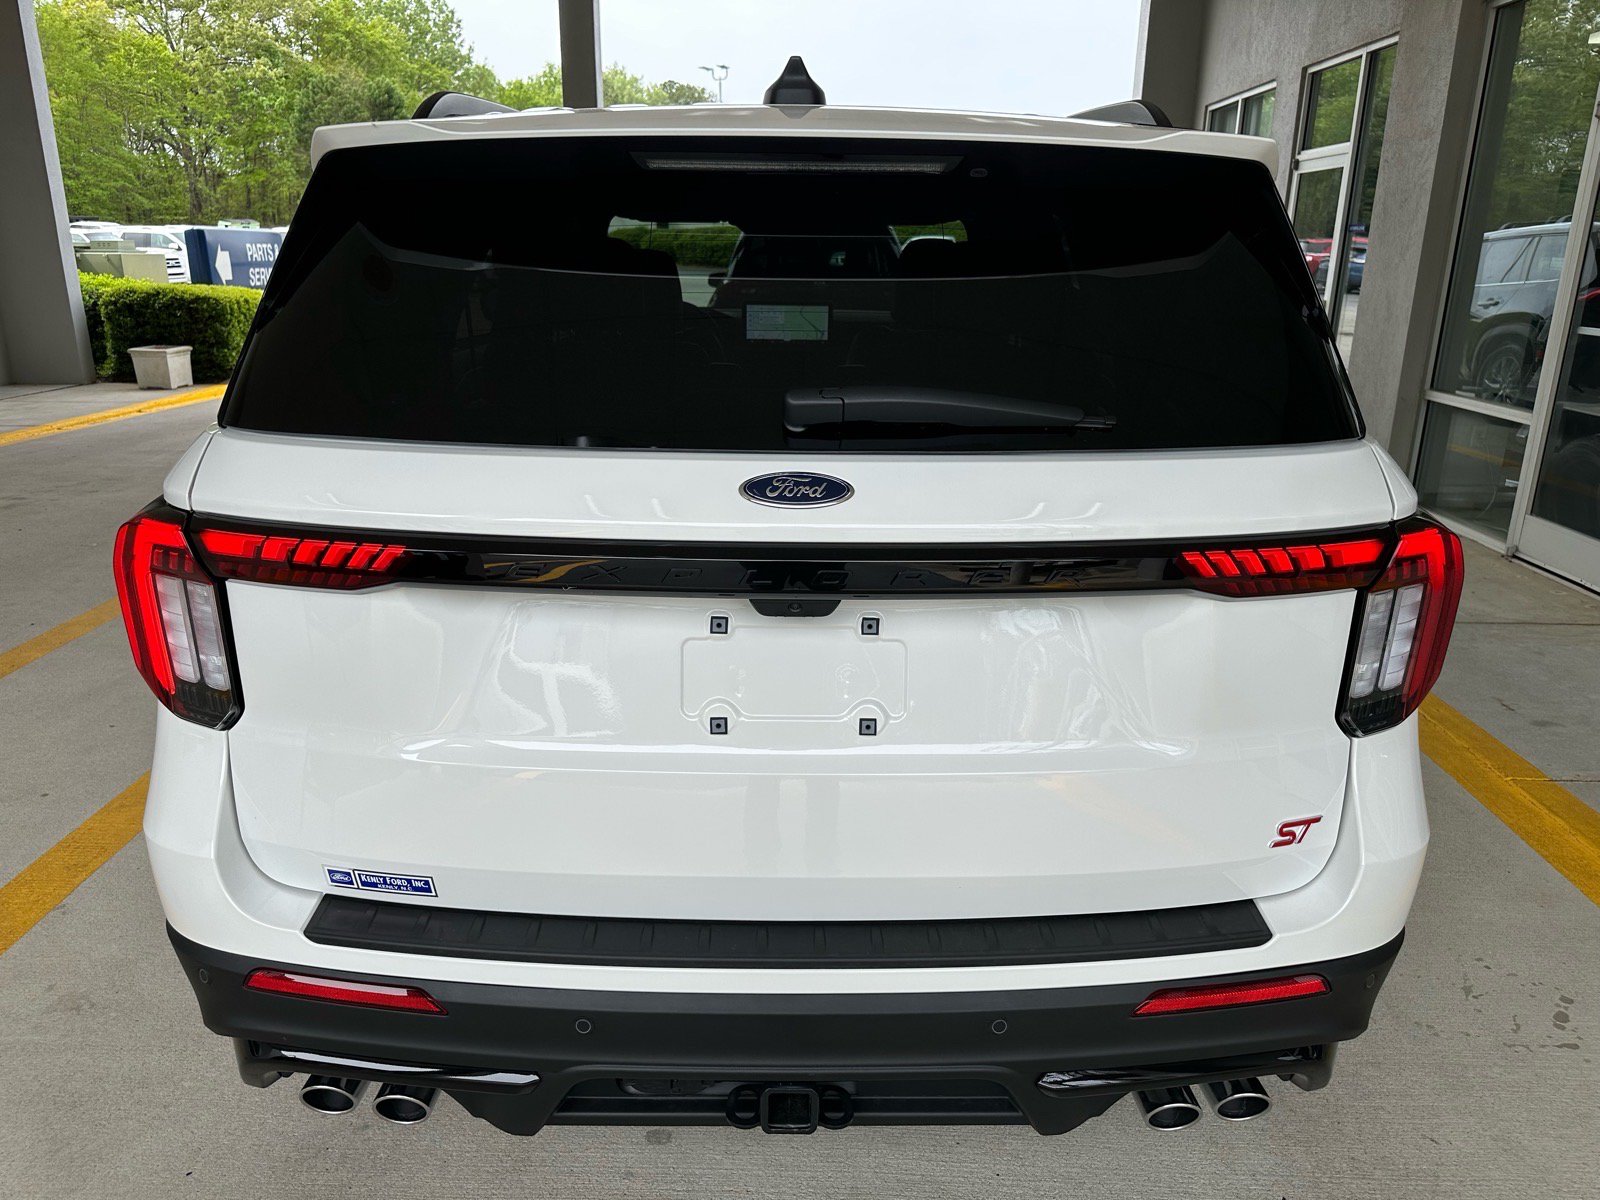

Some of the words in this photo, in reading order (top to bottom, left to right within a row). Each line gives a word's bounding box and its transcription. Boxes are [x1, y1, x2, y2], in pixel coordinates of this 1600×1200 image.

[246, 243, 273, 261] PARTS
[765, 476, 827, 498] Ford
[504, 561, 1088, 588] EXPLORER
[1269, 814, 1323, 848] ST
[360, 874, 384, 884] KENLY
[386, 877, 410, 887] FORD,
[411, 879, 428, 888] INC.
